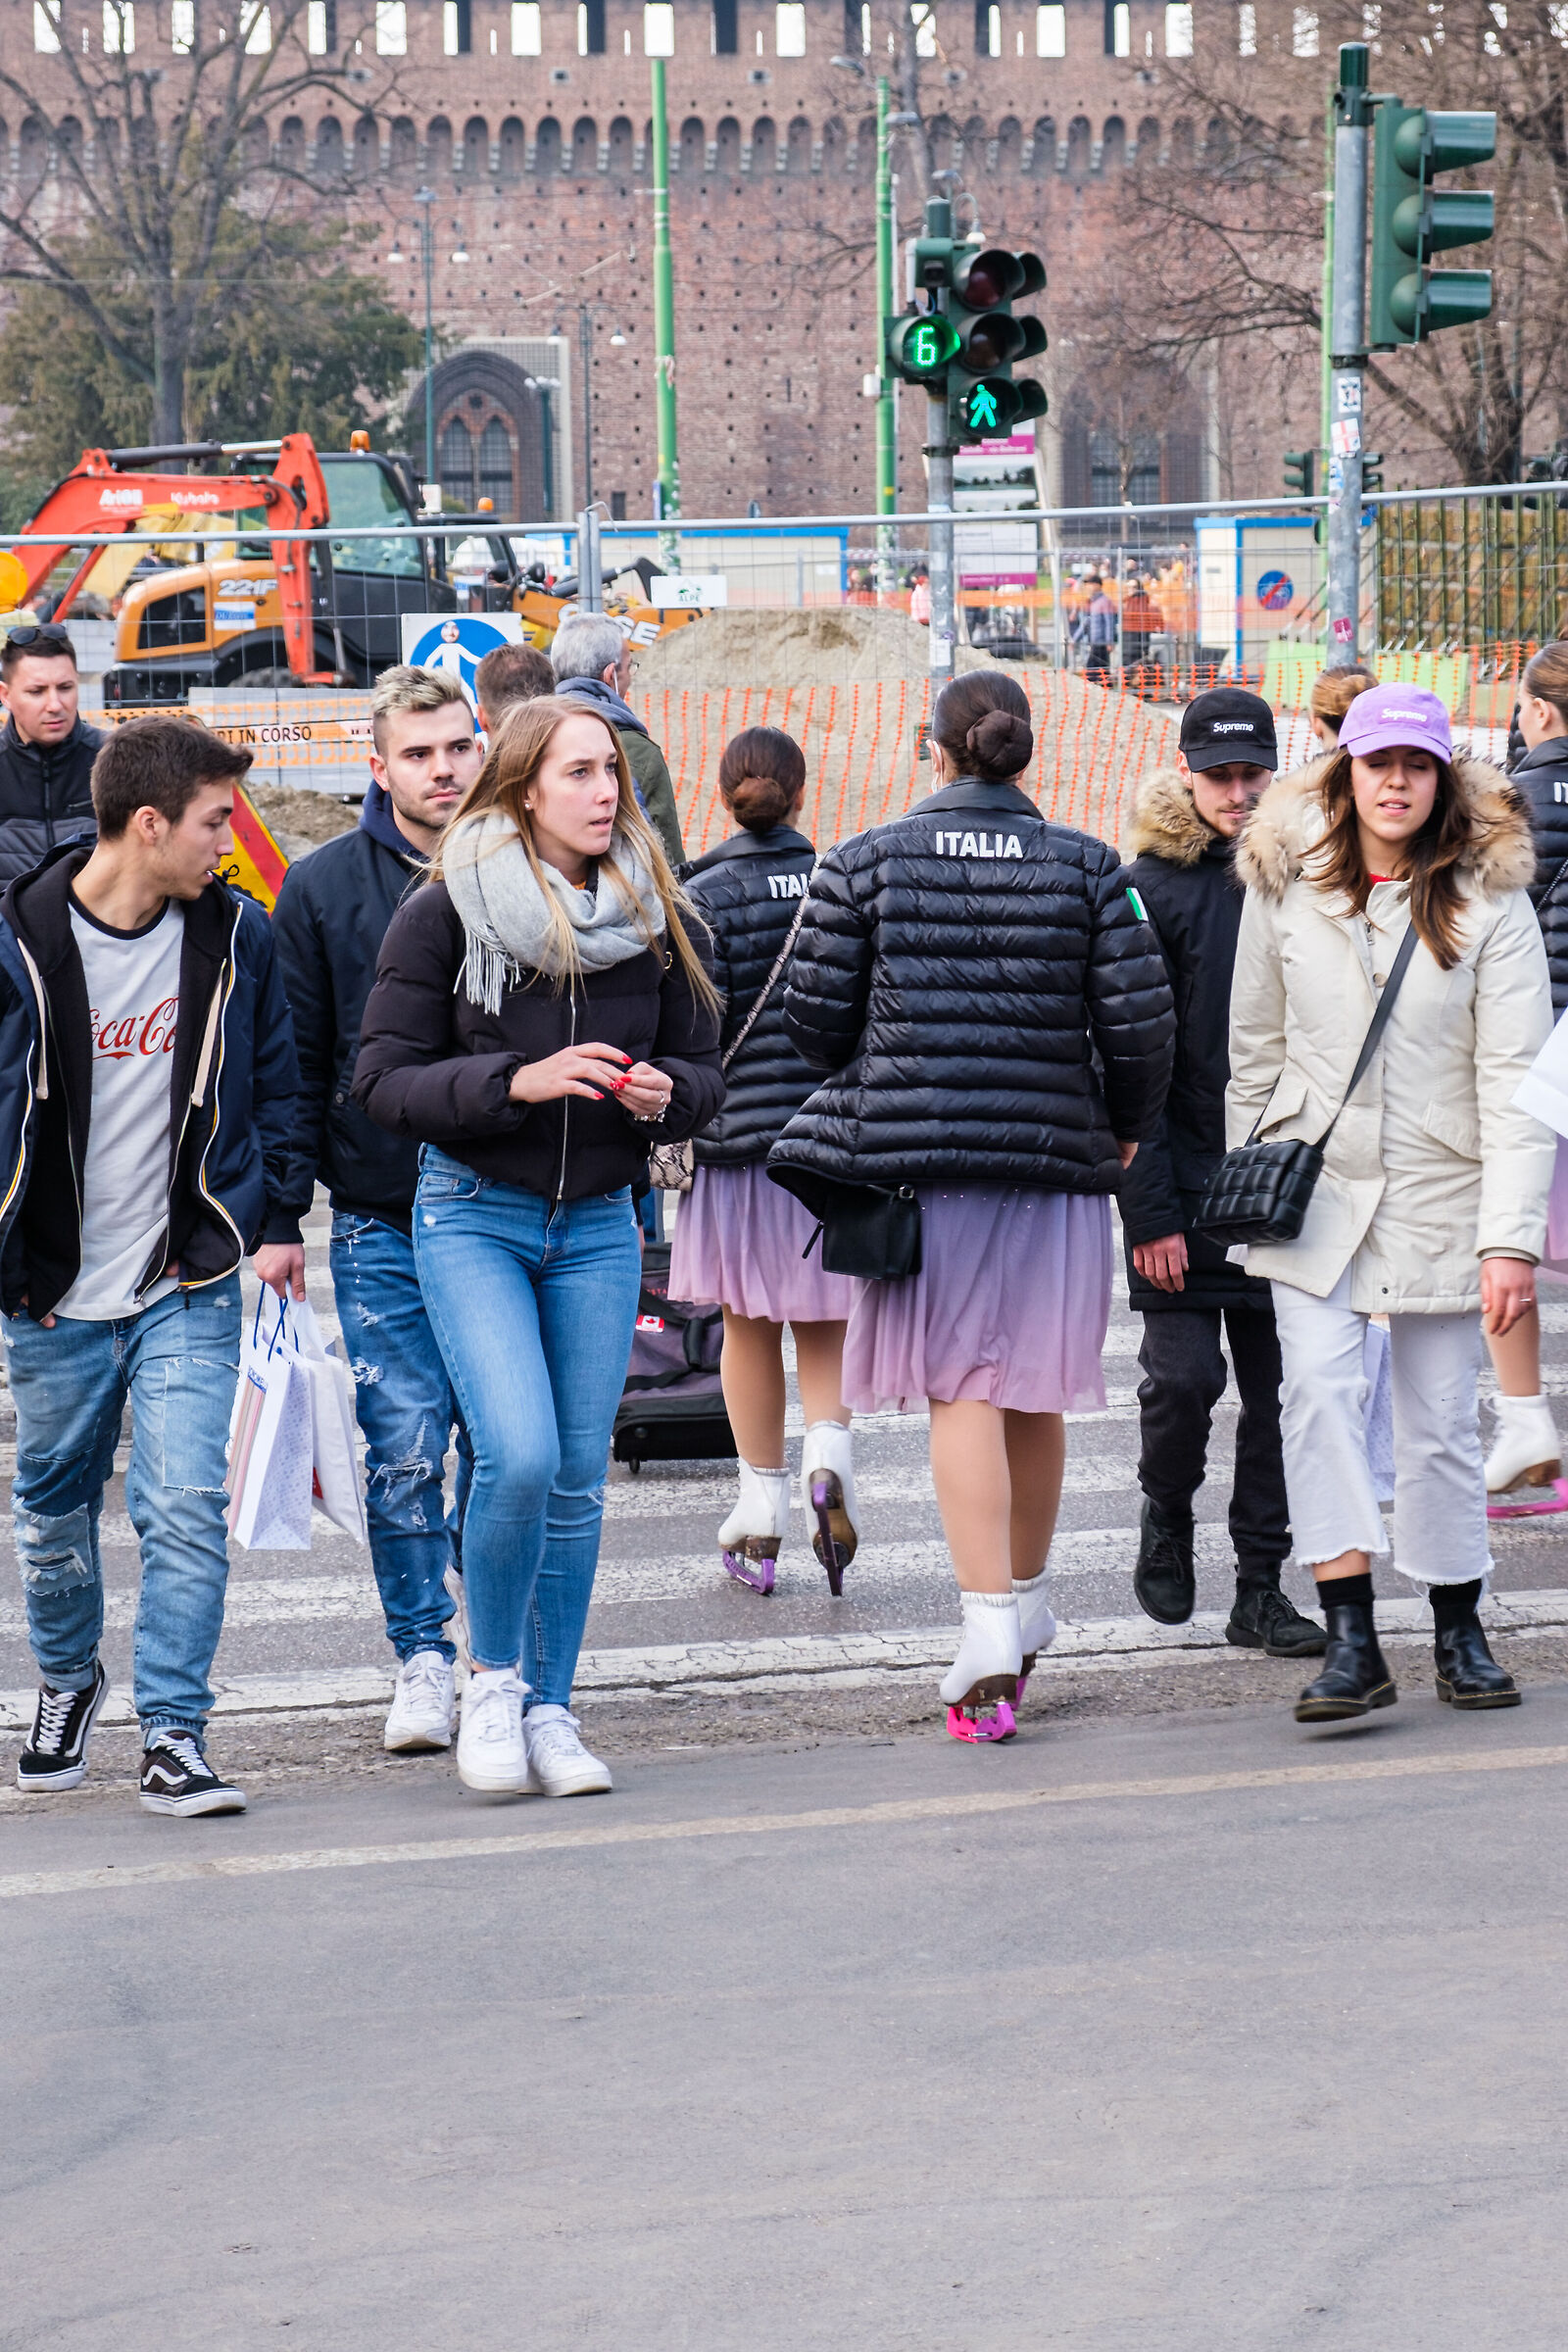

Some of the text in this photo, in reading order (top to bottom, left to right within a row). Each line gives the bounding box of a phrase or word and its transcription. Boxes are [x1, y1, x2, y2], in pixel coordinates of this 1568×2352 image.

[916, 326, 936, 367] 6
[218, 578, 278, 597] 221F
[1381, 708, 1428, 722] Supreme
[239, 729, 256, 744] IN
[261, 726, 312, 743] CORSO
[1213, 721, 1254, 734] Supreme
[936, 831, 1024, 858] ITALIA
